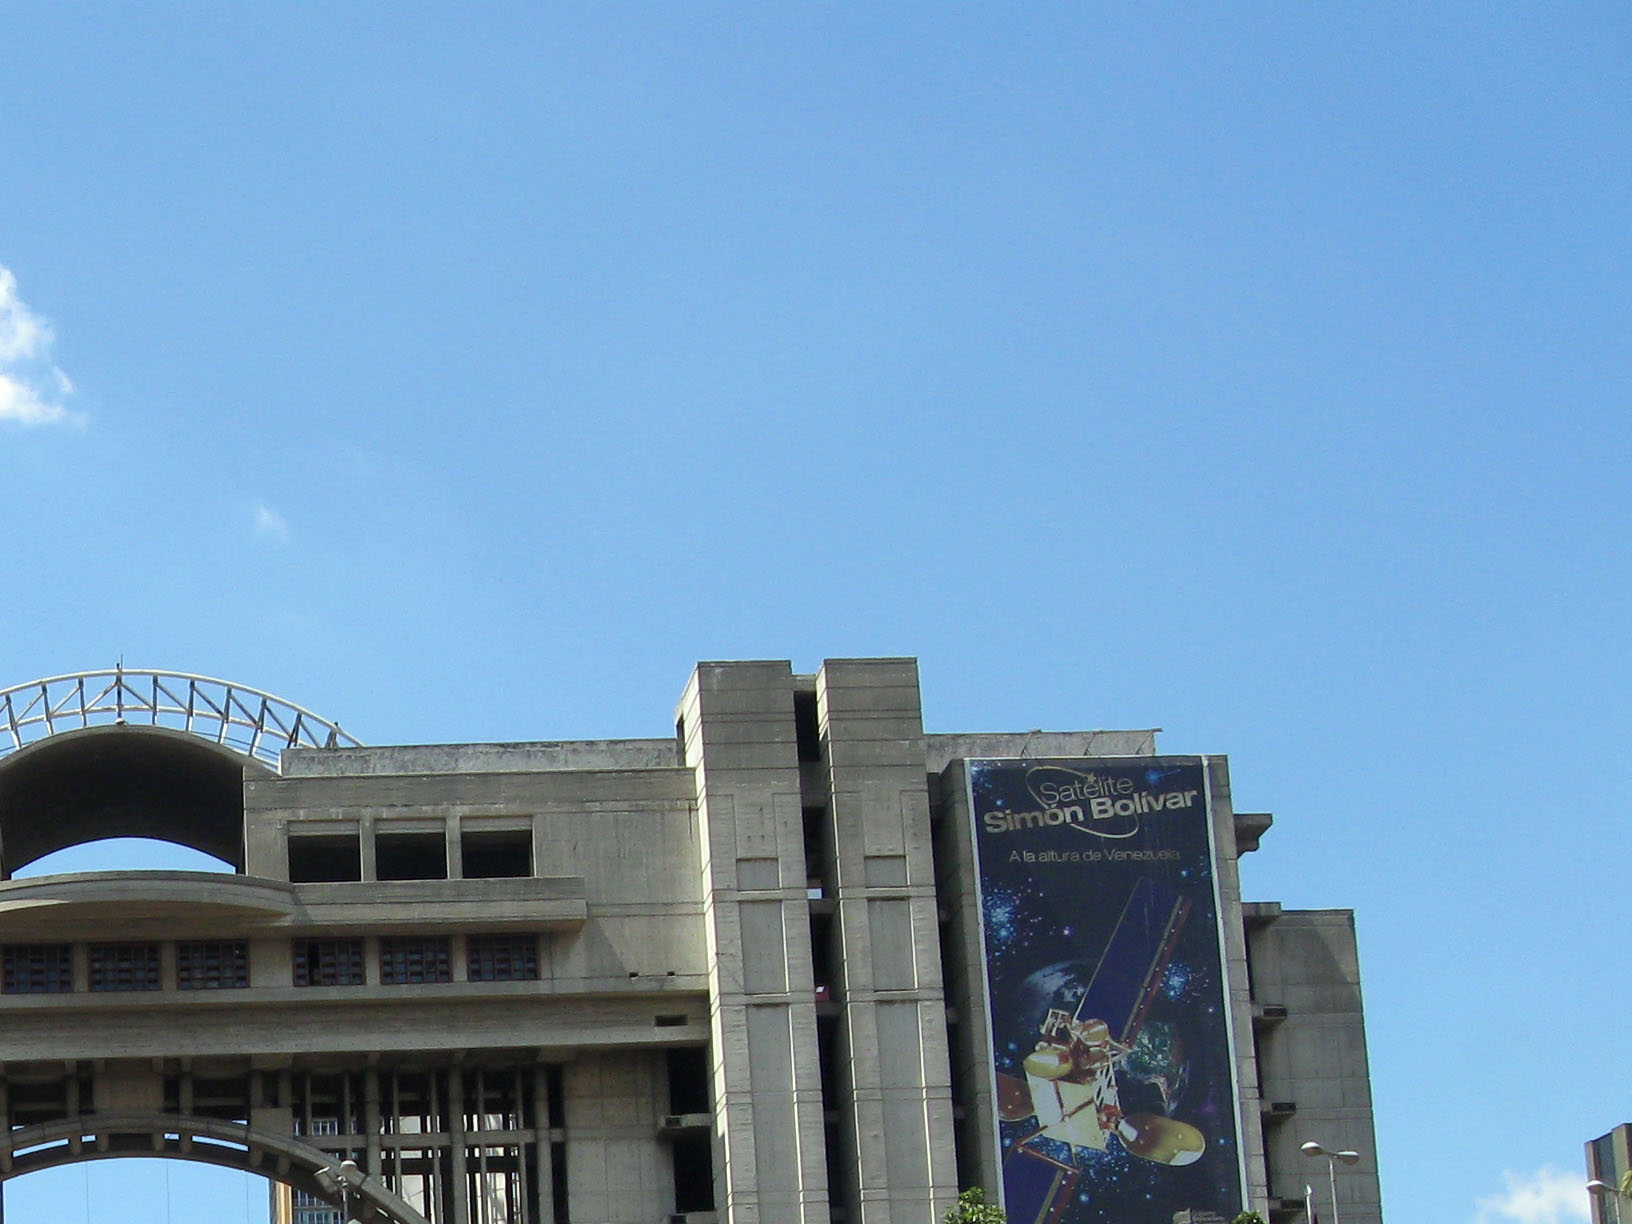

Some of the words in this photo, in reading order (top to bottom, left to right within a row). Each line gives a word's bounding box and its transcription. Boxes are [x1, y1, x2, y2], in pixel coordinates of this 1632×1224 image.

[983, 803, 1084, 834] Simón
[1090, 788, 1198, 820] Bolívar
[1009, 850, 1021, 863] A
[1023, 849, 1036, 863] la
[1038, 849, 1080, 862] altura
[1082, 849, 1102, 862] de
[1103, 848, 1181, 861] Venezuela
